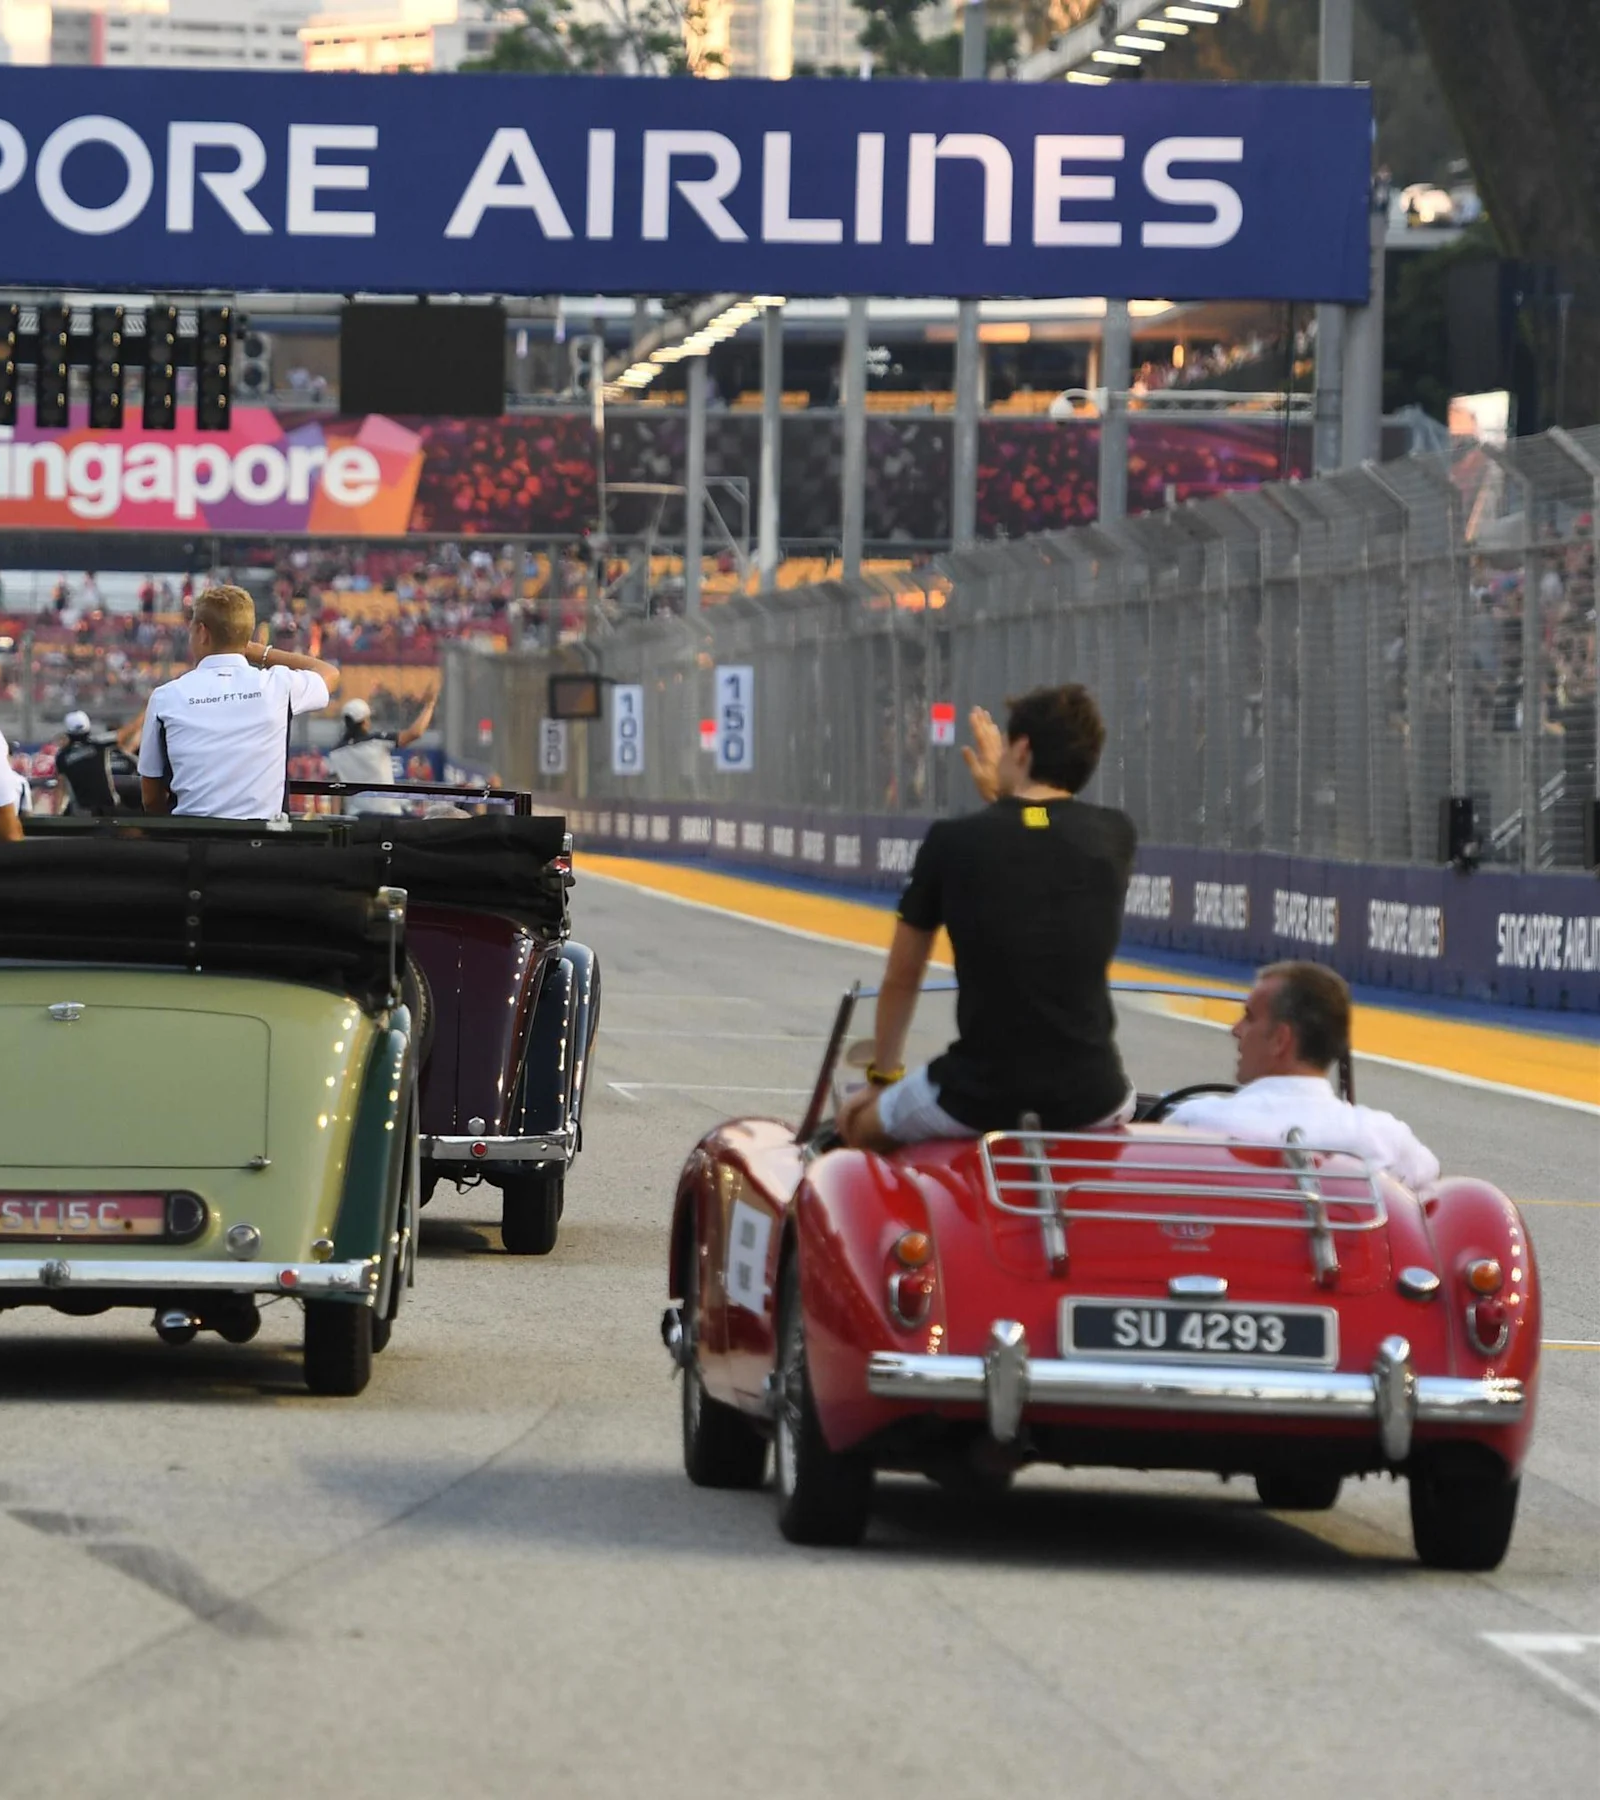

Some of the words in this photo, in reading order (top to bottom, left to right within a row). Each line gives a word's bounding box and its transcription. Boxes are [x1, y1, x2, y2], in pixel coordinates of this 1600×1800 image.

[445, 127, 1245, 248] AIRLINES
[188, 695, 221, 705] Sauber
[237, 690, 262, 700] Team
[619, 692, 638, 765] 100
[723, 673, 746, 764] 150
[1496, 912, 1564, 970] SINGAPORE
[1113, 1309, 1167, 1348] SU
[1177, 1312, 1287, 1352] 4293
